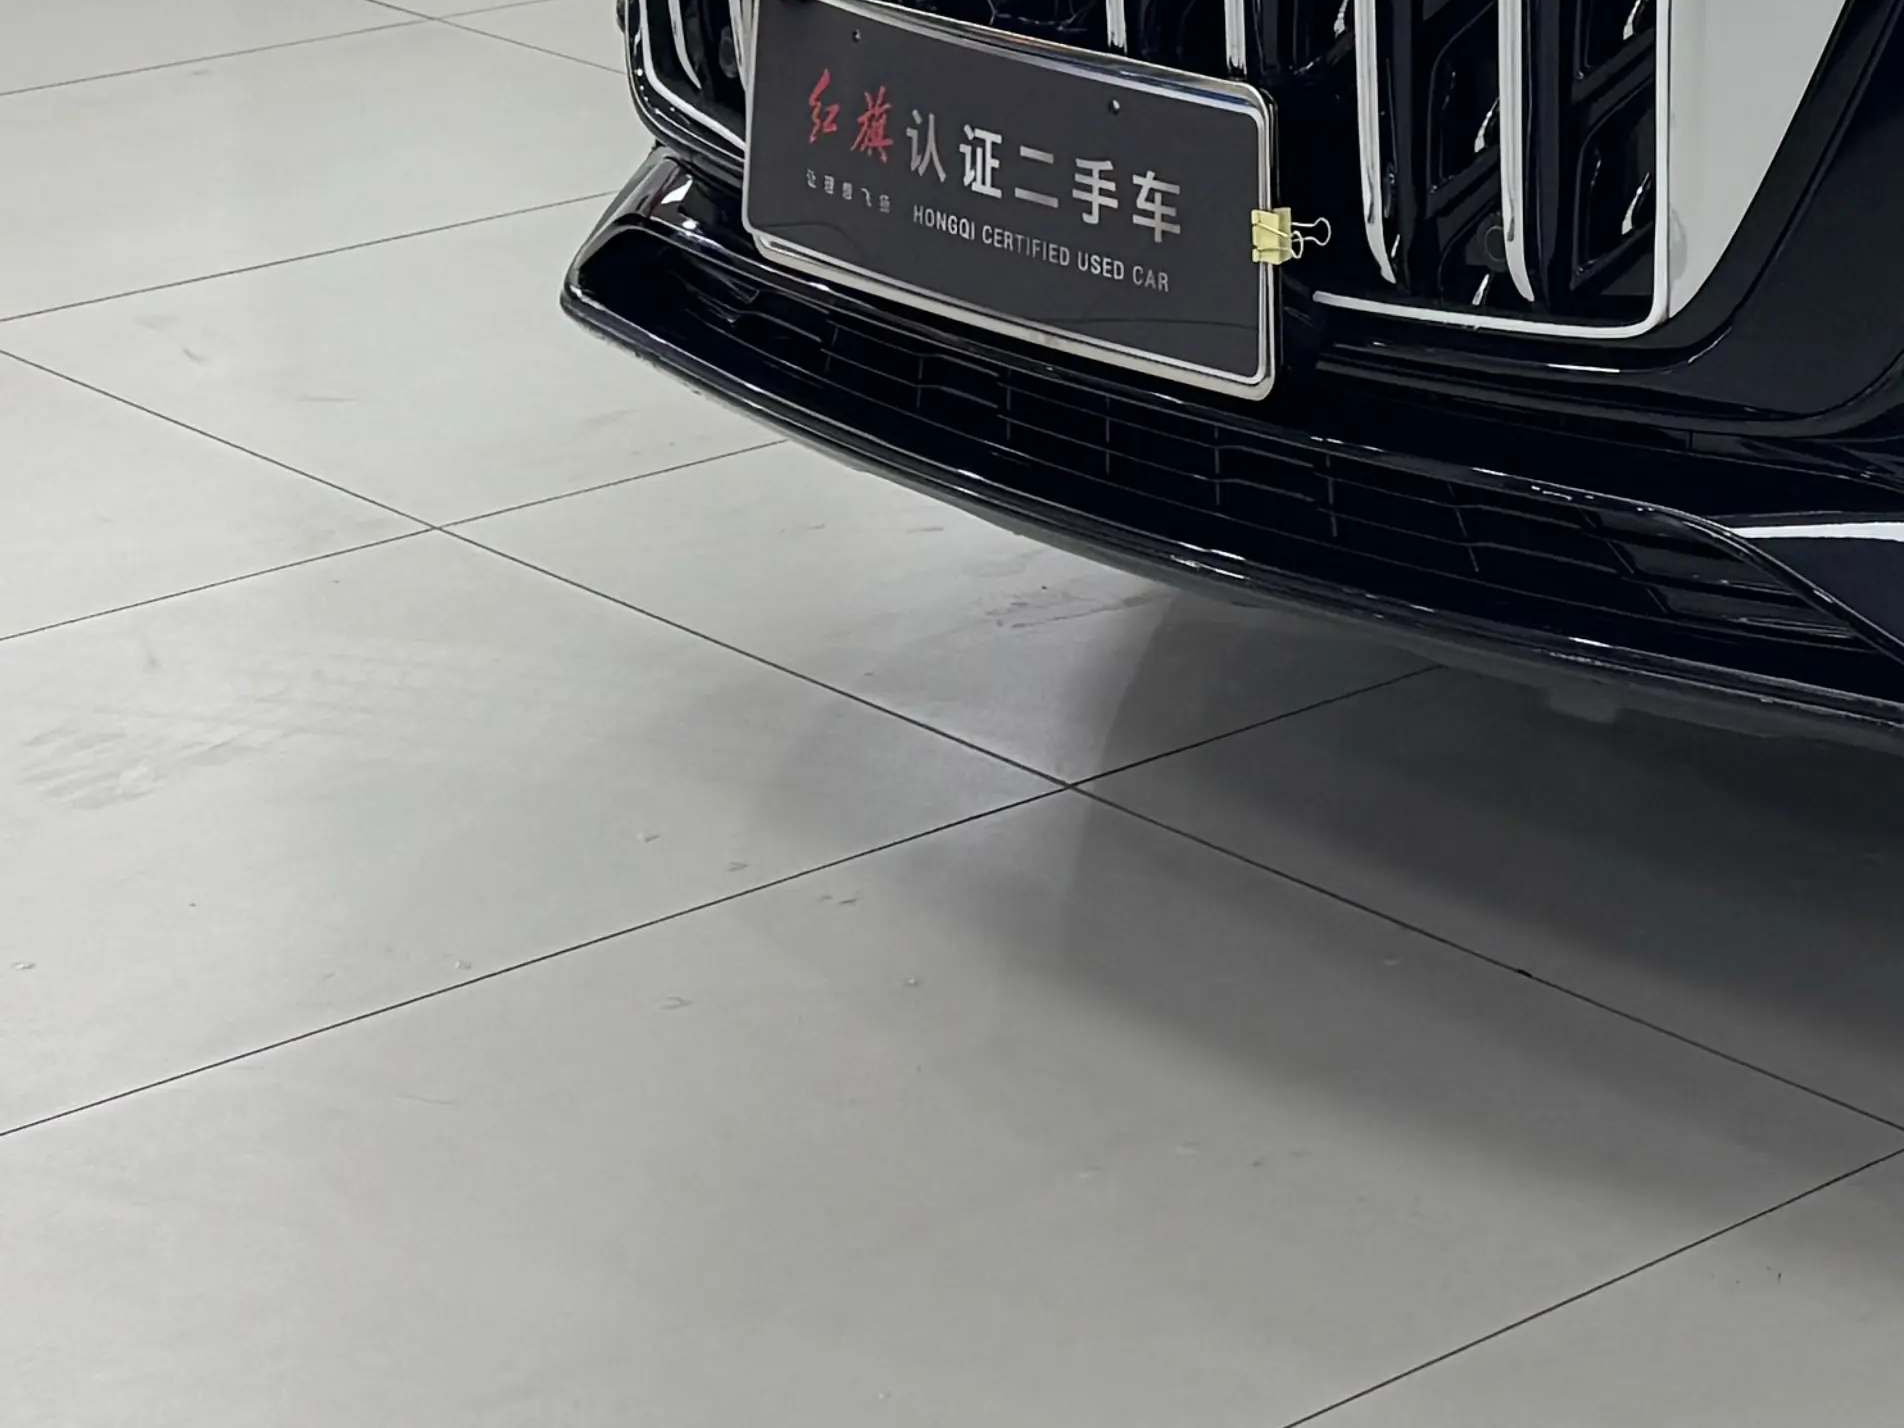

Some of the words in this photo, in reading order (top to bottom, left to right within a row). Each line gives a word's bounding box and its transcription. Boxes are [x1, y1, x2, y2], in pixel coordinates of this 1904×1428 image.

[809, 68, 894, 163] 红旗
[906, 109, 1182, 244] 认证二手车
[913, 205, 976, 241] HONGQI
[982, 224, 1071, 268] CERTIFIED
[1077, 252, 1126, 282] USED
[1132, 265, 1171, 293] CAR
